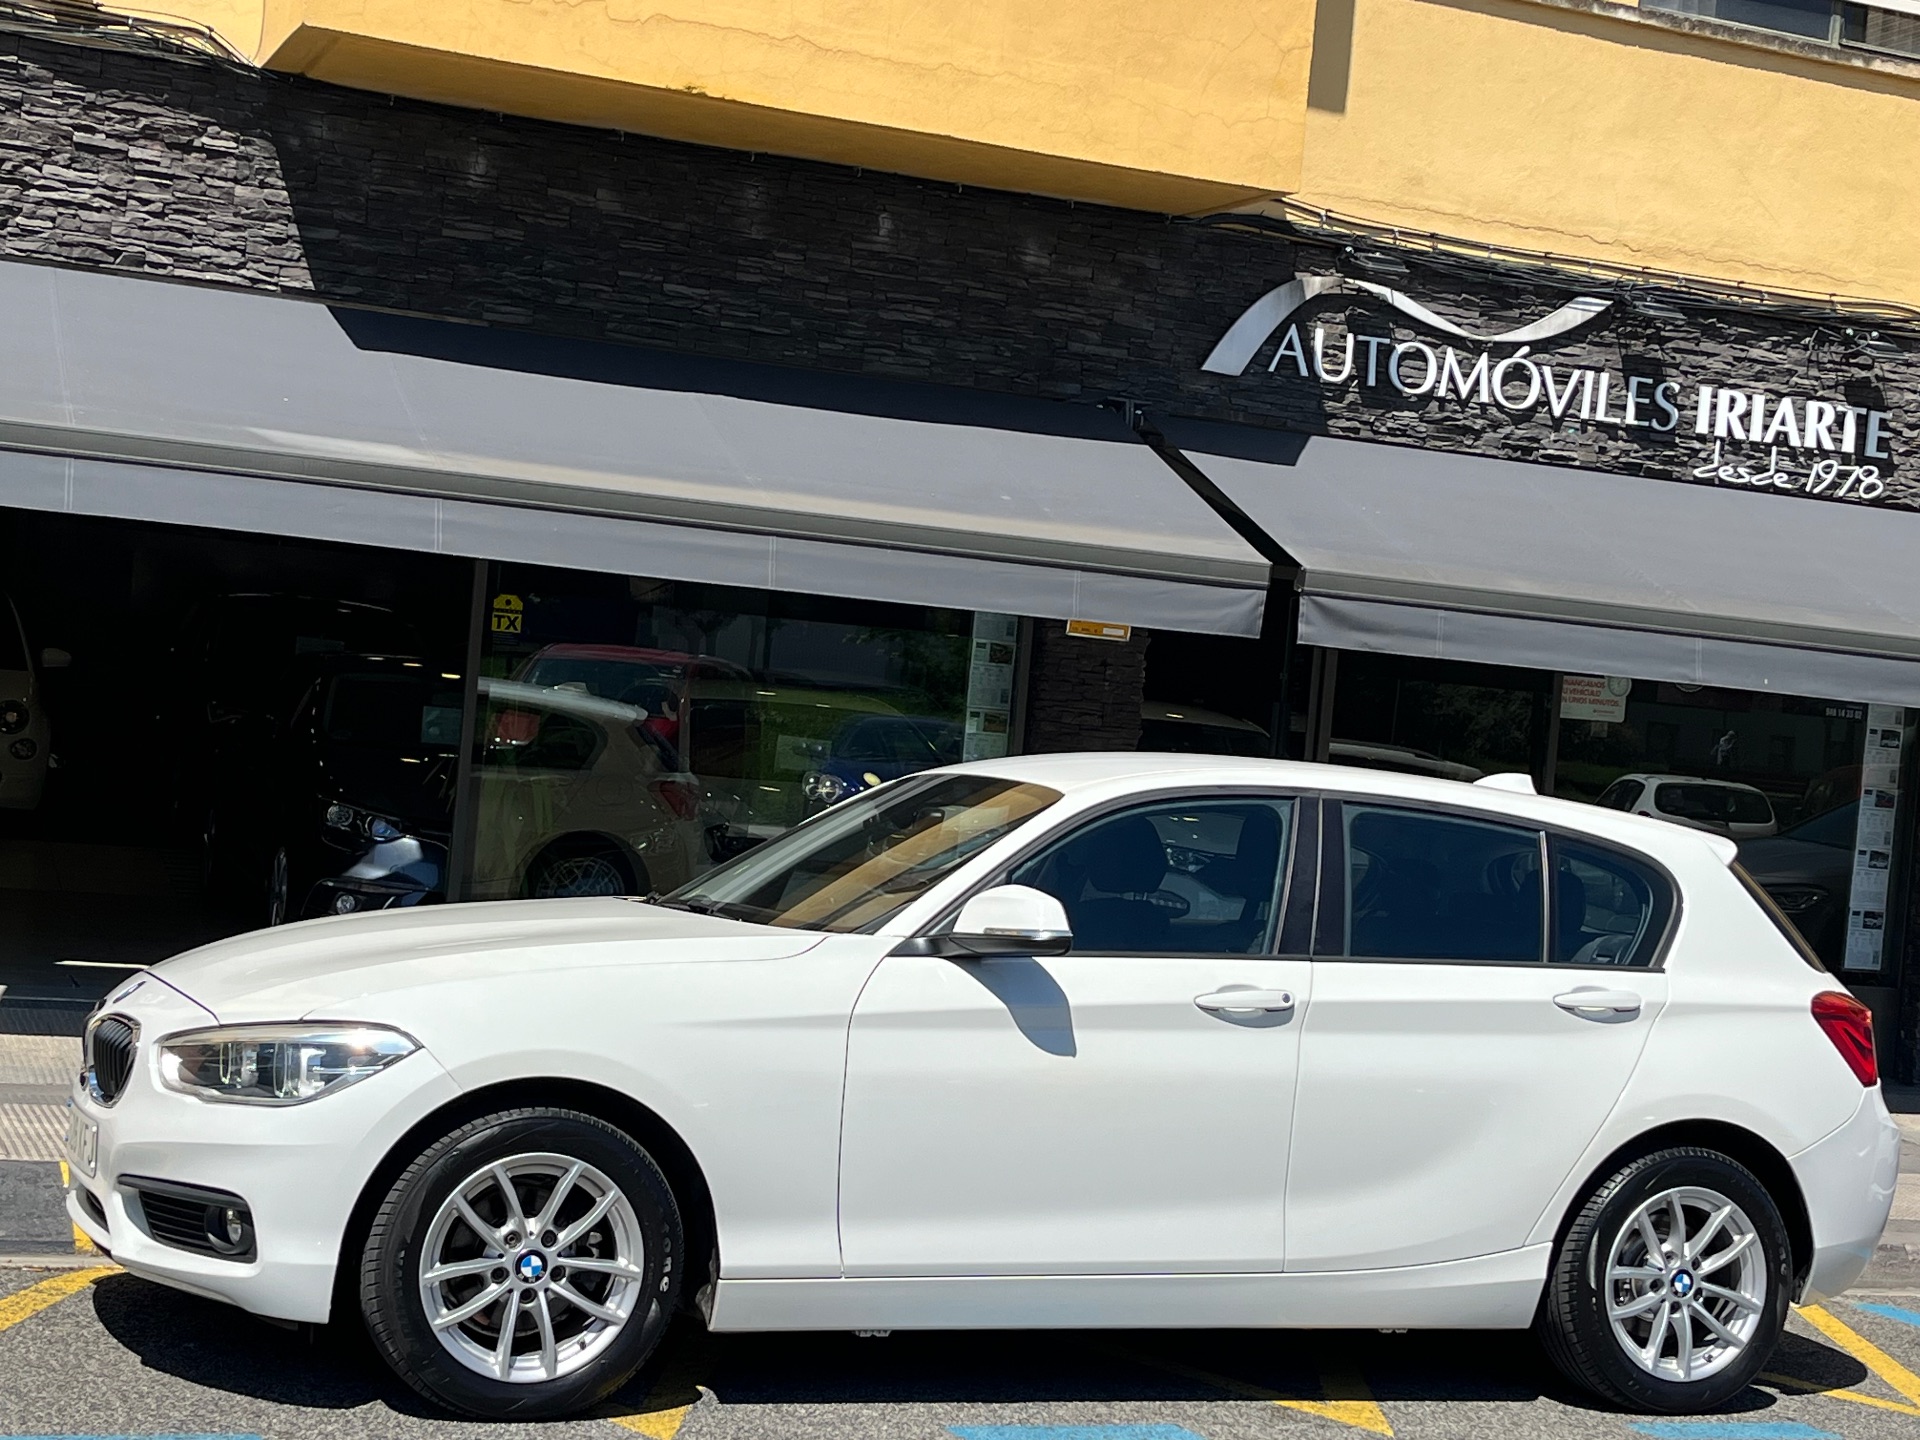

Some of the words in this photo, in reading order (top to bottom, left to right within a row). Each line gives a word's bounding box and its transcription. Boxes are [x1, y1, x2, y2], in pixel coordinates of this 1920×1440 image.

[1267, 322, 1680, 432] AUTOMÓVILES
[1695, 386, 1893, 459] IRIARTE
[1693, 438, 1794, 489] desde
[1805, 459, 1884, 499] 1978
[494, 614, 519, 631] TX
